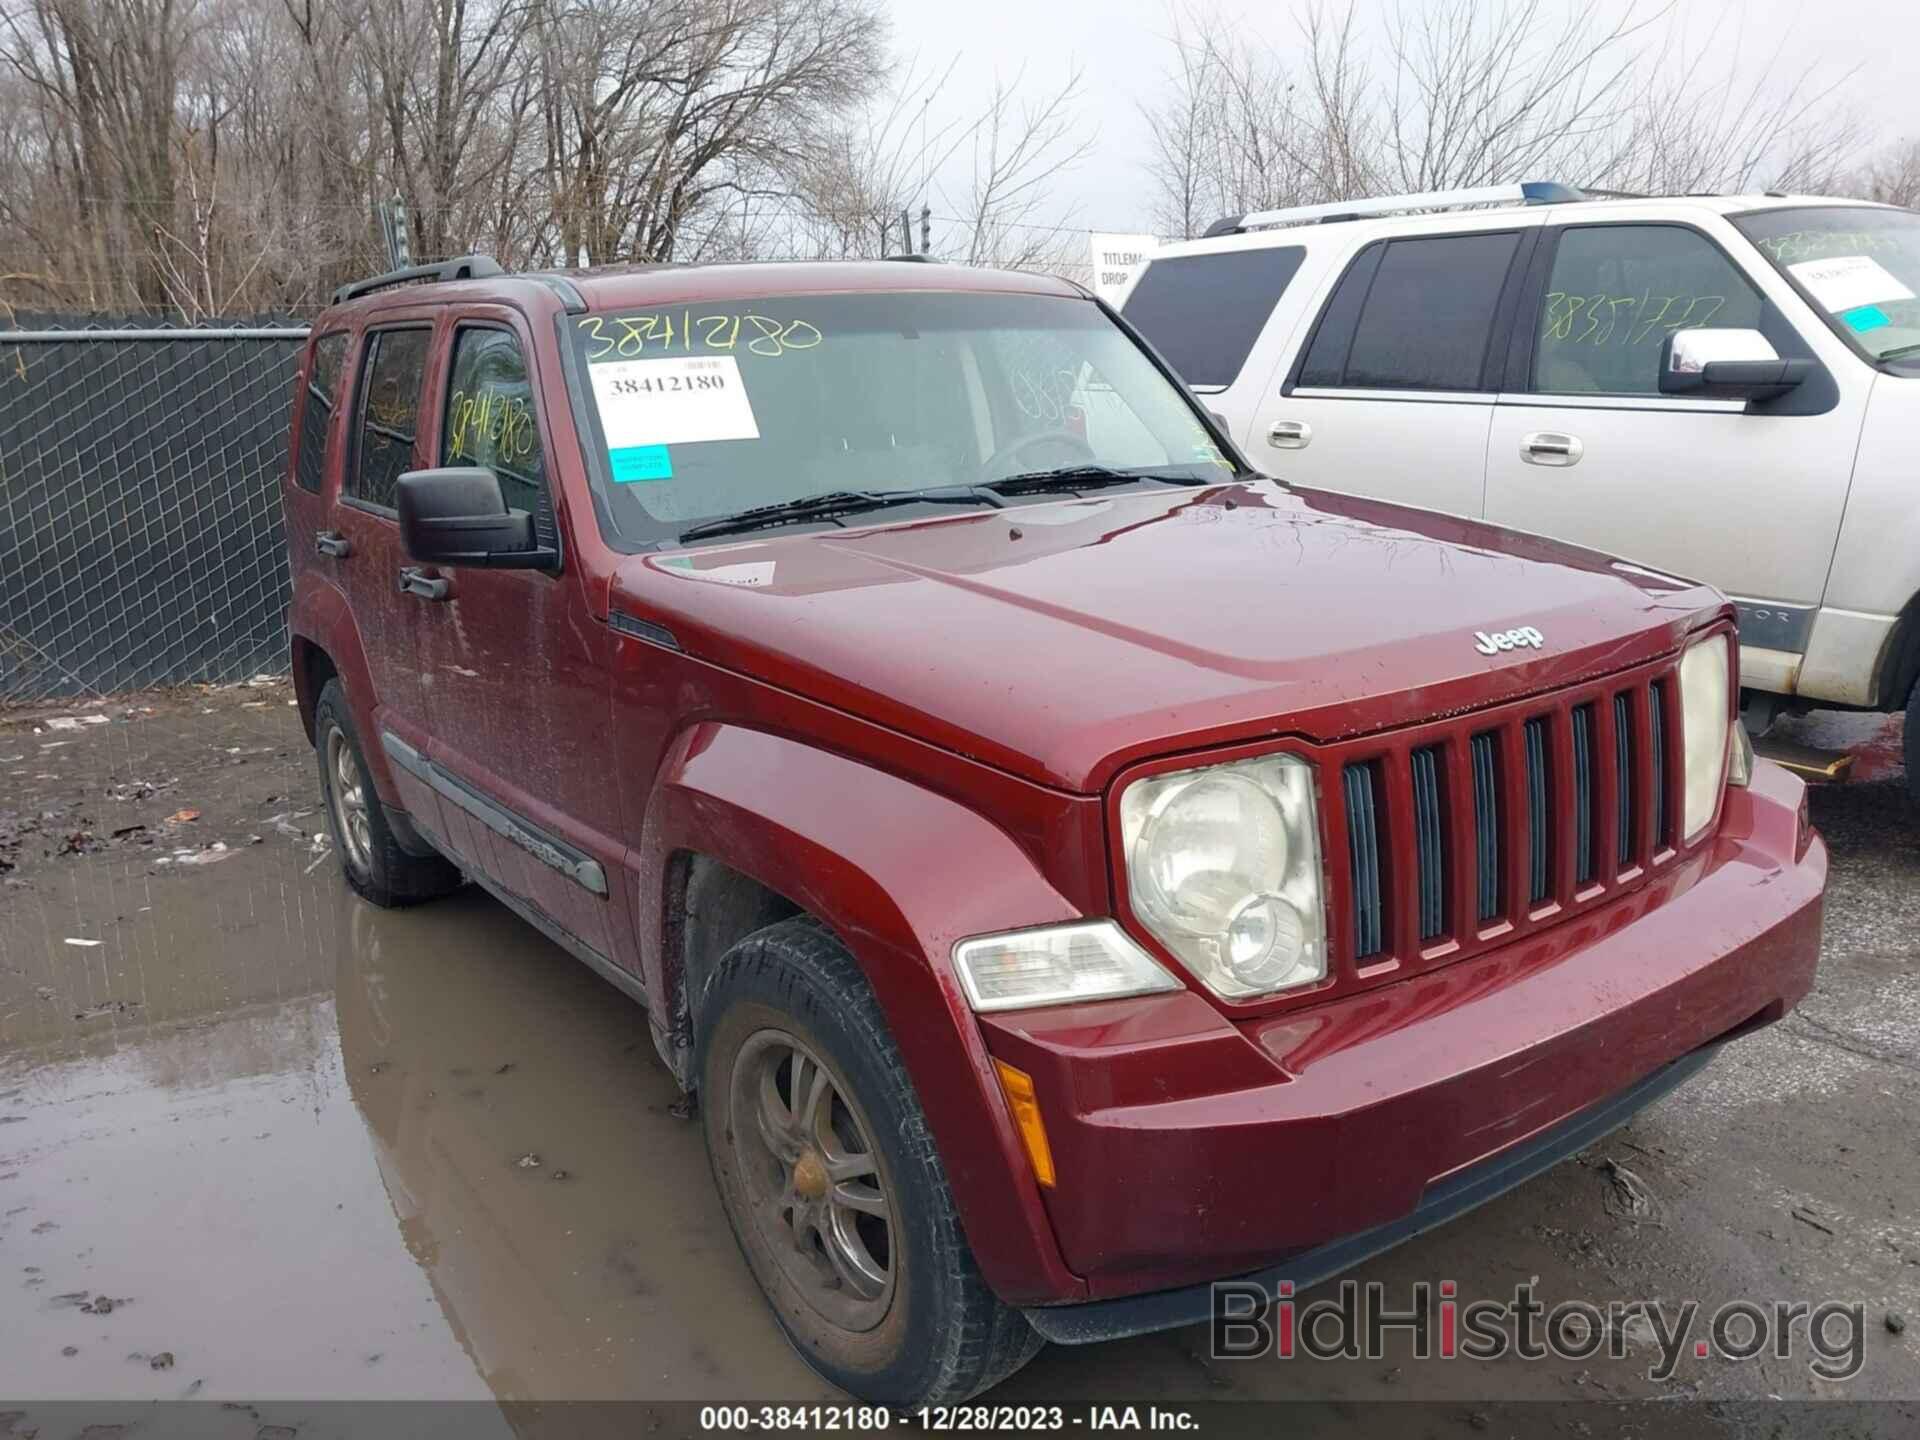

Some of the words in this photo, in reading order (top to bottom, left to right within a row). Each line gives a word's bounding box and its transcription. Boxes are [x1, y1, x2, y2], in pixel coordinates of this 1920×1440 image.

[1102, 272, 1128, 286] DROP
[578, 309, 822, 358] 38412180
[609, 374, 725, 396] 38412180
[1473, 626, 1544, 656] Jeep
